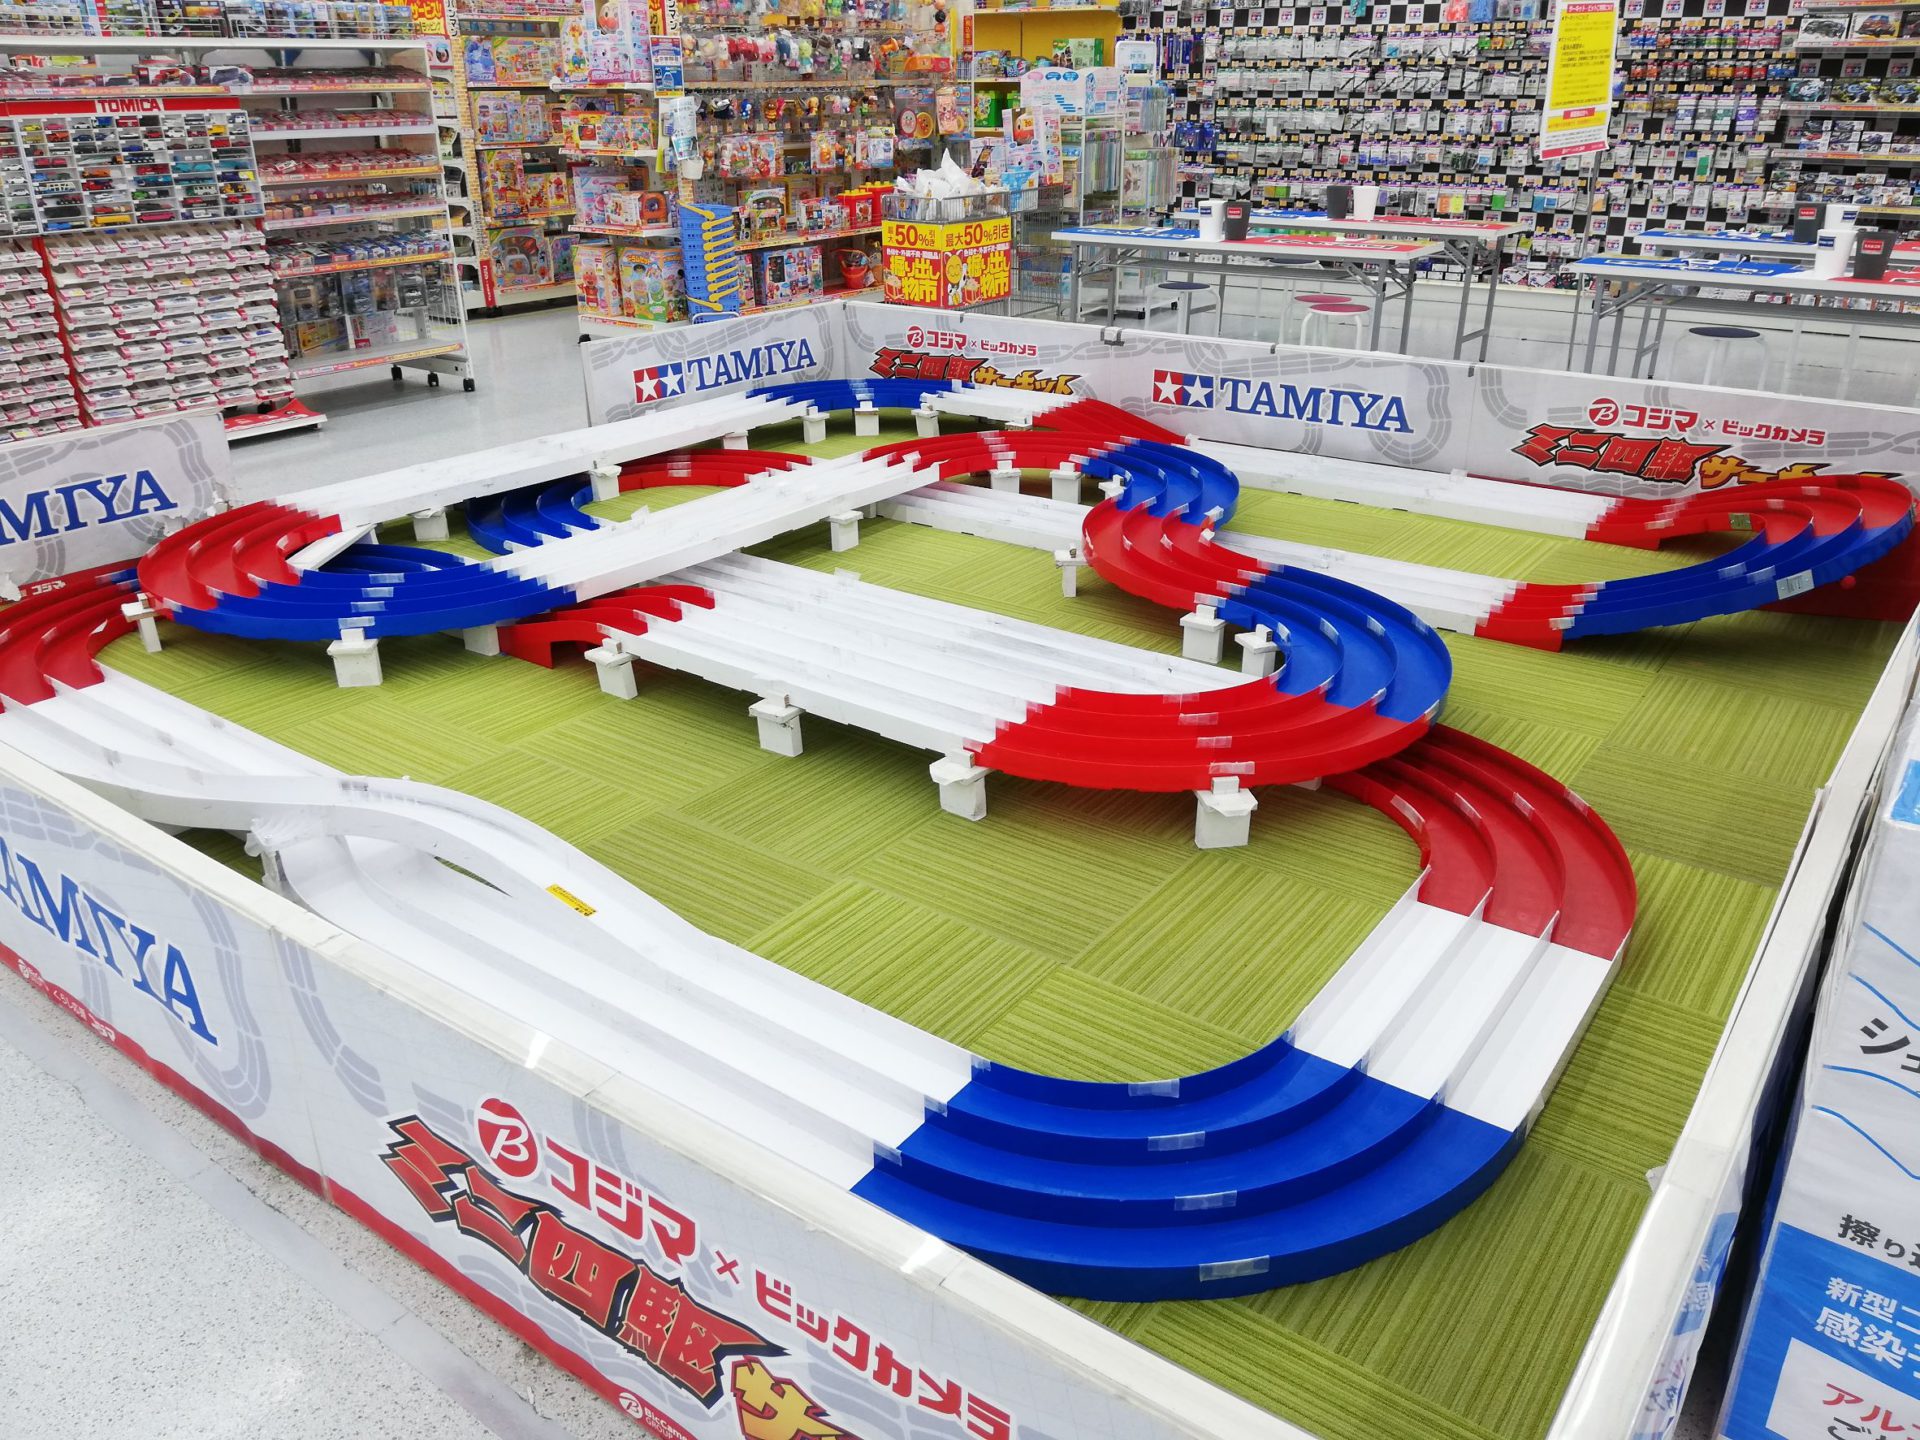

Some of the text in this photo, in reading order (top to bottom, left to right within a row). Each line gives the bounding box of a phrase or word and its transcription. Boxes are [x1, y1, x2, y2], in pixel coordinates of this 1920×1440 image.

[98, 98, 161, 112] TOMICA
[895, 224, 930, 247] 50%
[687, 338, 817, 391] TAMIYA
[926, 330, 968, 349] コジマ
[980, 338, 1038, 357] ビックカメラ
[1220, 377, 1414, 434] TAMIYA
[1623, 404, 1698, 433] コジマ
[1722, 419, 1826, 446] ビックカメラ
[546, 1138, 697, 1265] コジマ
[756, 1270, 1010, 1440] ビックカメラ
[1822, 1382, 1920, 1440] アル
